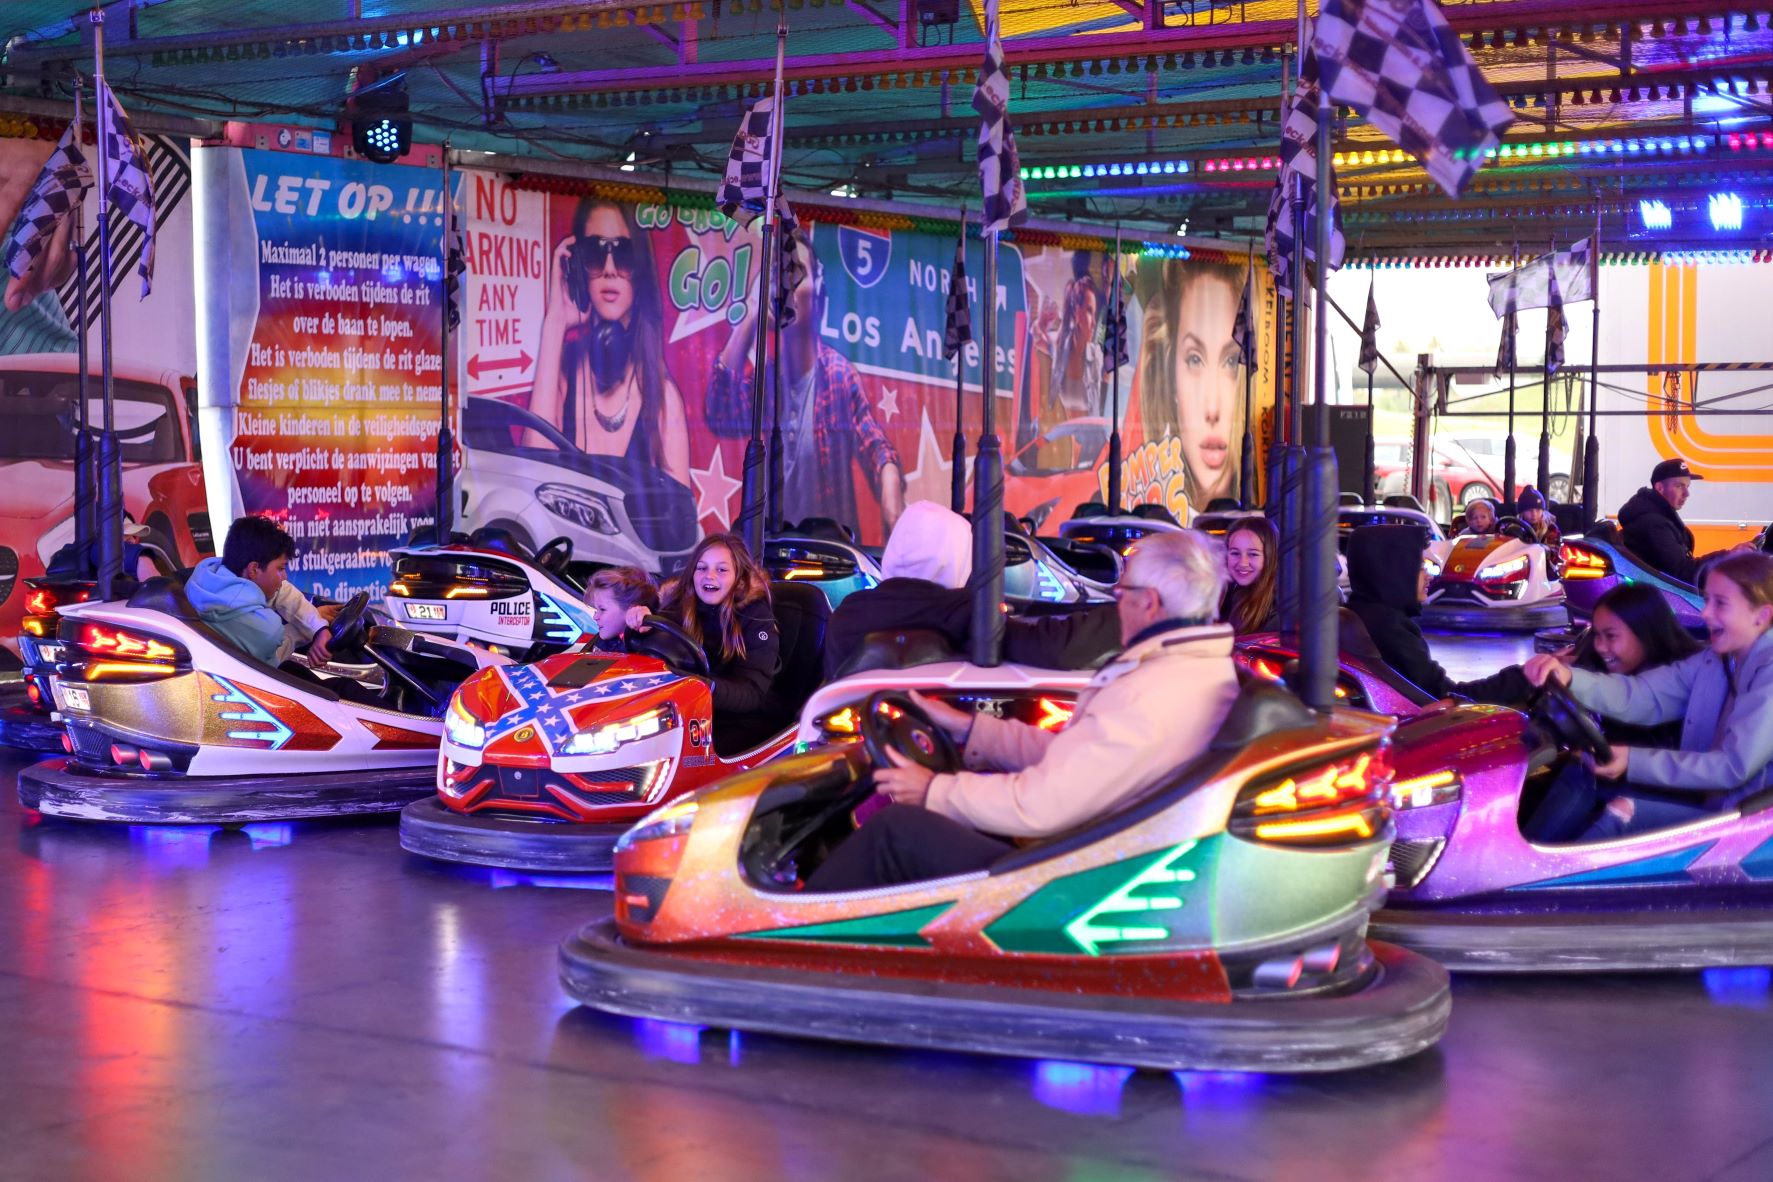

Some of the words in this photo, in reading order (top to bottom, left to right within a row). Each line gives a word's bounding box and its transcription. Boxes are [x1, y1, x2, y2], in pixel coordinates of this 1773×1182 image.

[251, 174, 331, 216] LET
[338, 182, 393, 221] OP
[403, 187, 443, 226] !!!
[476, 175, 518, 226] NO
[261, 240, 316, 266] Maximaal
[319, 247, 327, 266] 2
[329, 249, 379, 272] personen
[382, 252, 401, 275] per
[403, 255, 440, 278] wagen.
[466, 230, 541, 280] ARKING
[856, 239, 872, 276] 5
[270, 275, 292, 299] Het
[294, 277, 304, 299] is
[307, 280, 358, 302] verboden
[361, 281, 398, 308] tijdens
[401, 283, 414, 305] de
[416, 283, 430, 305] rit
[669, 244, 752, 325] GO!
[909, 259, 977, 302] NORH
[478, 283, 519, 312] ANY
[293, 316, 319, 334] over
[322, 312, 335, 335] de
[338, 313, 364, 336] baan
[367, 315, 378, 336] te
[381, 315, 413, 341] lopen.
[476, 318, 522, 347] TIME
[251, 343, 272, 367] Het
[275, 344, 285, 367] is
[288, 345, 340, 368] verboden
[343, 347, 380, 374] tijdens
[384, 348, 396, 370] de
[398, 348, 413, 370] rit
[901, 317, 1015, 376] Anees
[248, 378, 285, 406] flesjes
[288, 378, 299, 400] of
[302, 379, 340, 406] blikjes
[343, 380, 376, 401] drank
[379, 385, 401, 401] mee
[403, 382, 413, 401] te
[238, 411, 276, 436] Kleine
[280, 412, 331, 436] kinderen
[334, 414, 345, 436] in
[348, 414, 361, 436] de
[234, 447, 244, 470] U
[246, 448, 273, 470] bent
[276, 447, 329, 474] verplicht
[332, 447, 344, 470] de
[347, 447, 419, 475] aanwijzingen
[288, 481, 341, 508] personeel
[344, 486, 358, 508] op
[361, 482, 372, 502] te
[374, 482, 412, 507] volgen.
[308, 514, 330, 537] niet
[333, 513, 408, 540] aansprakelijk
[303, 547, 377, 576] stukgeraakte
[490, 601, 530, 615] POLICE
[498, 615, 530, 625] INTERCEPTOR
